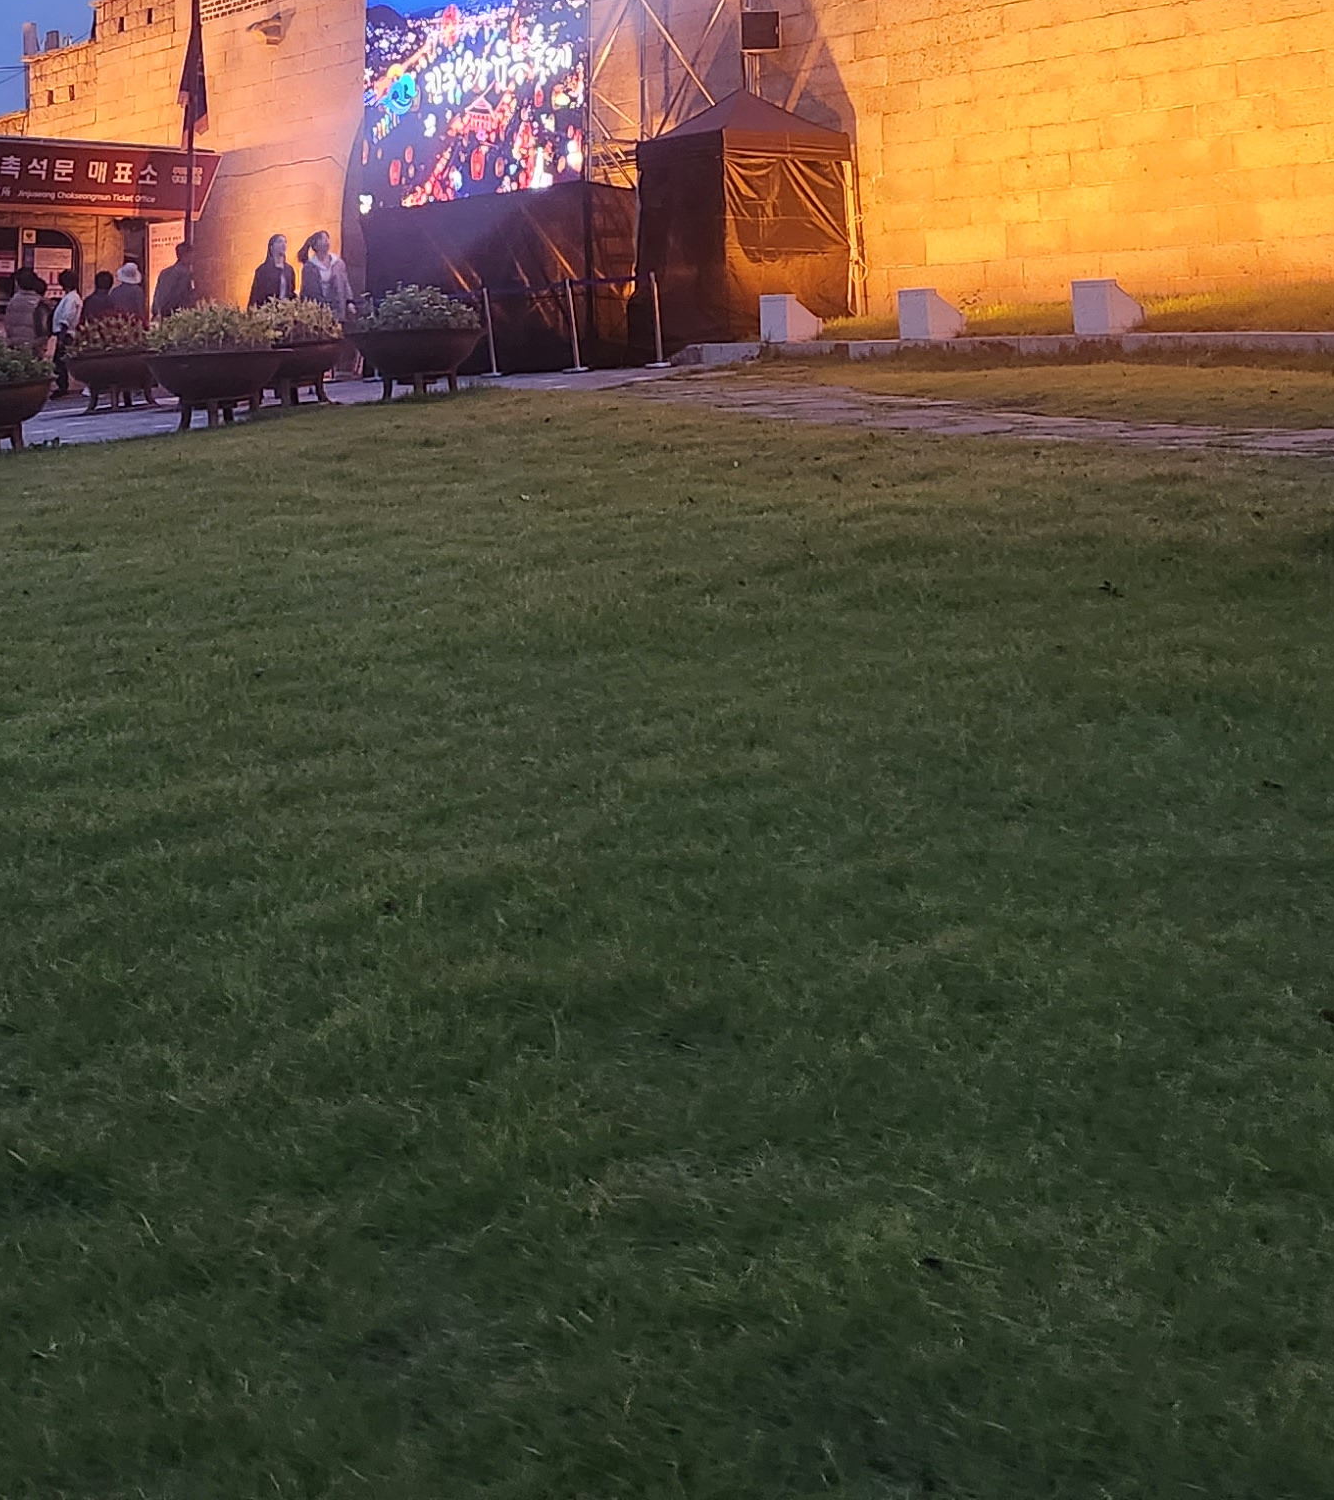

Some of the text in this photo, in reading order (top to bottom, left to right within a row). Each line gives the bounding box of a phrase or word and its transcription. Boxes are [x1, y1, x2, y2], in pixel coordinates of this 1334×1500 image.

[0, 155, 74, 182] 촉석문
[88, 161, 158, 185] 매표소
[17, 189, 156, 203] Jinjuseong Chokseongmun Ticket Office
